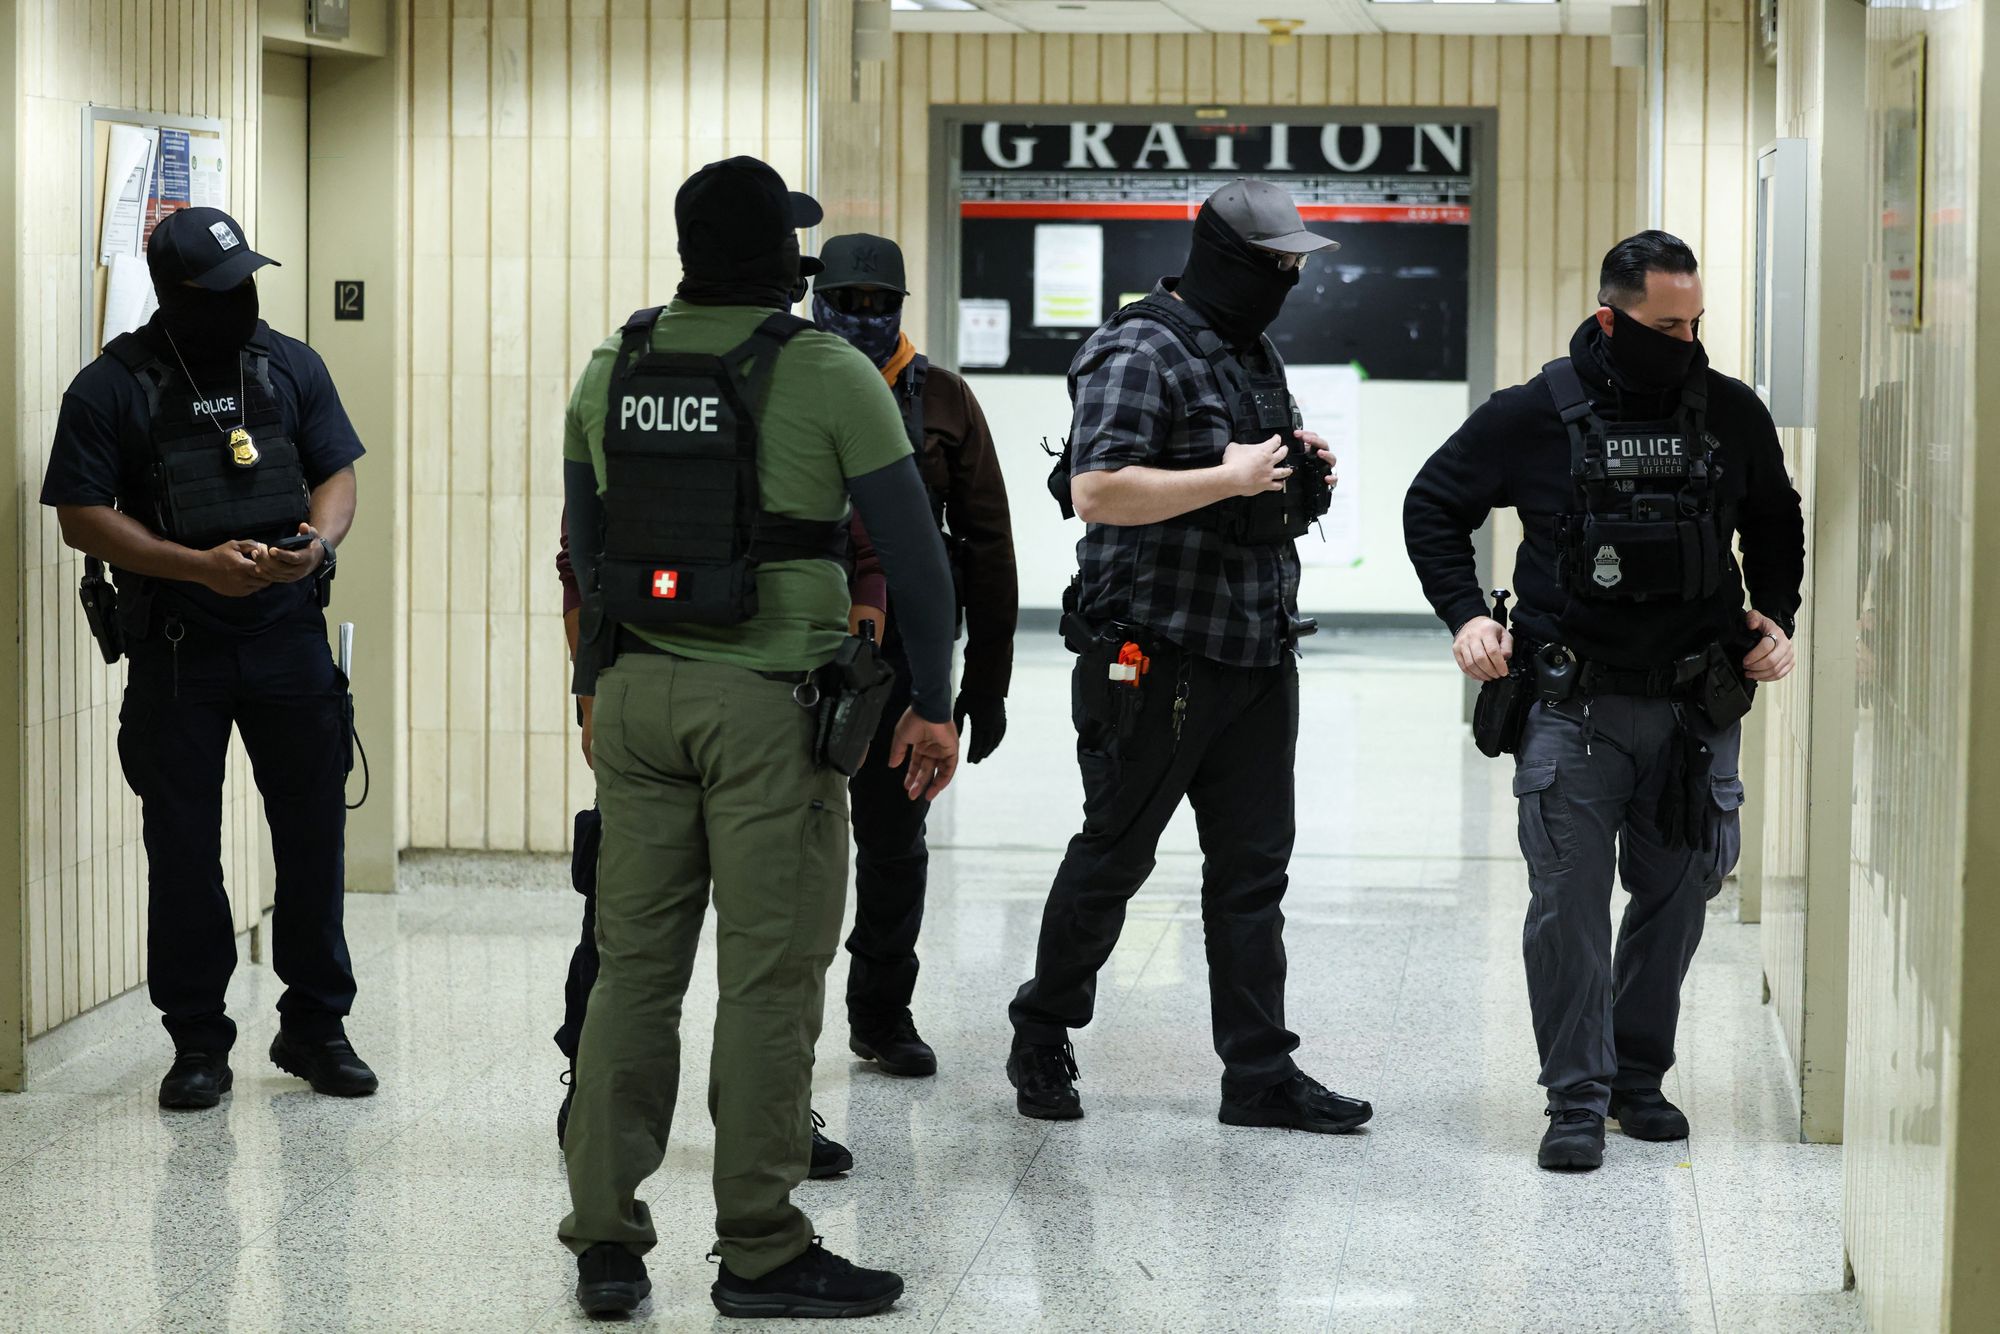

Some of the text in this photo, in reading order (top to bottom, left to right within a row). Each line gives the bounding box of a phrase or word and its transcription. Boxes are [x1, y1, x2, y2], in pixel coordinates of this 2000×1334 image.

[340, 284, 359, 311] 12
[192, 396, 236, 416] POLICE
[620, 395, 720, 432] POLICE
[1606, 438, 1683, 458] POLICE
[1641, 458, 1682, 466] FEDERAL
[1643, 465, 1682, 475] OFFICER
